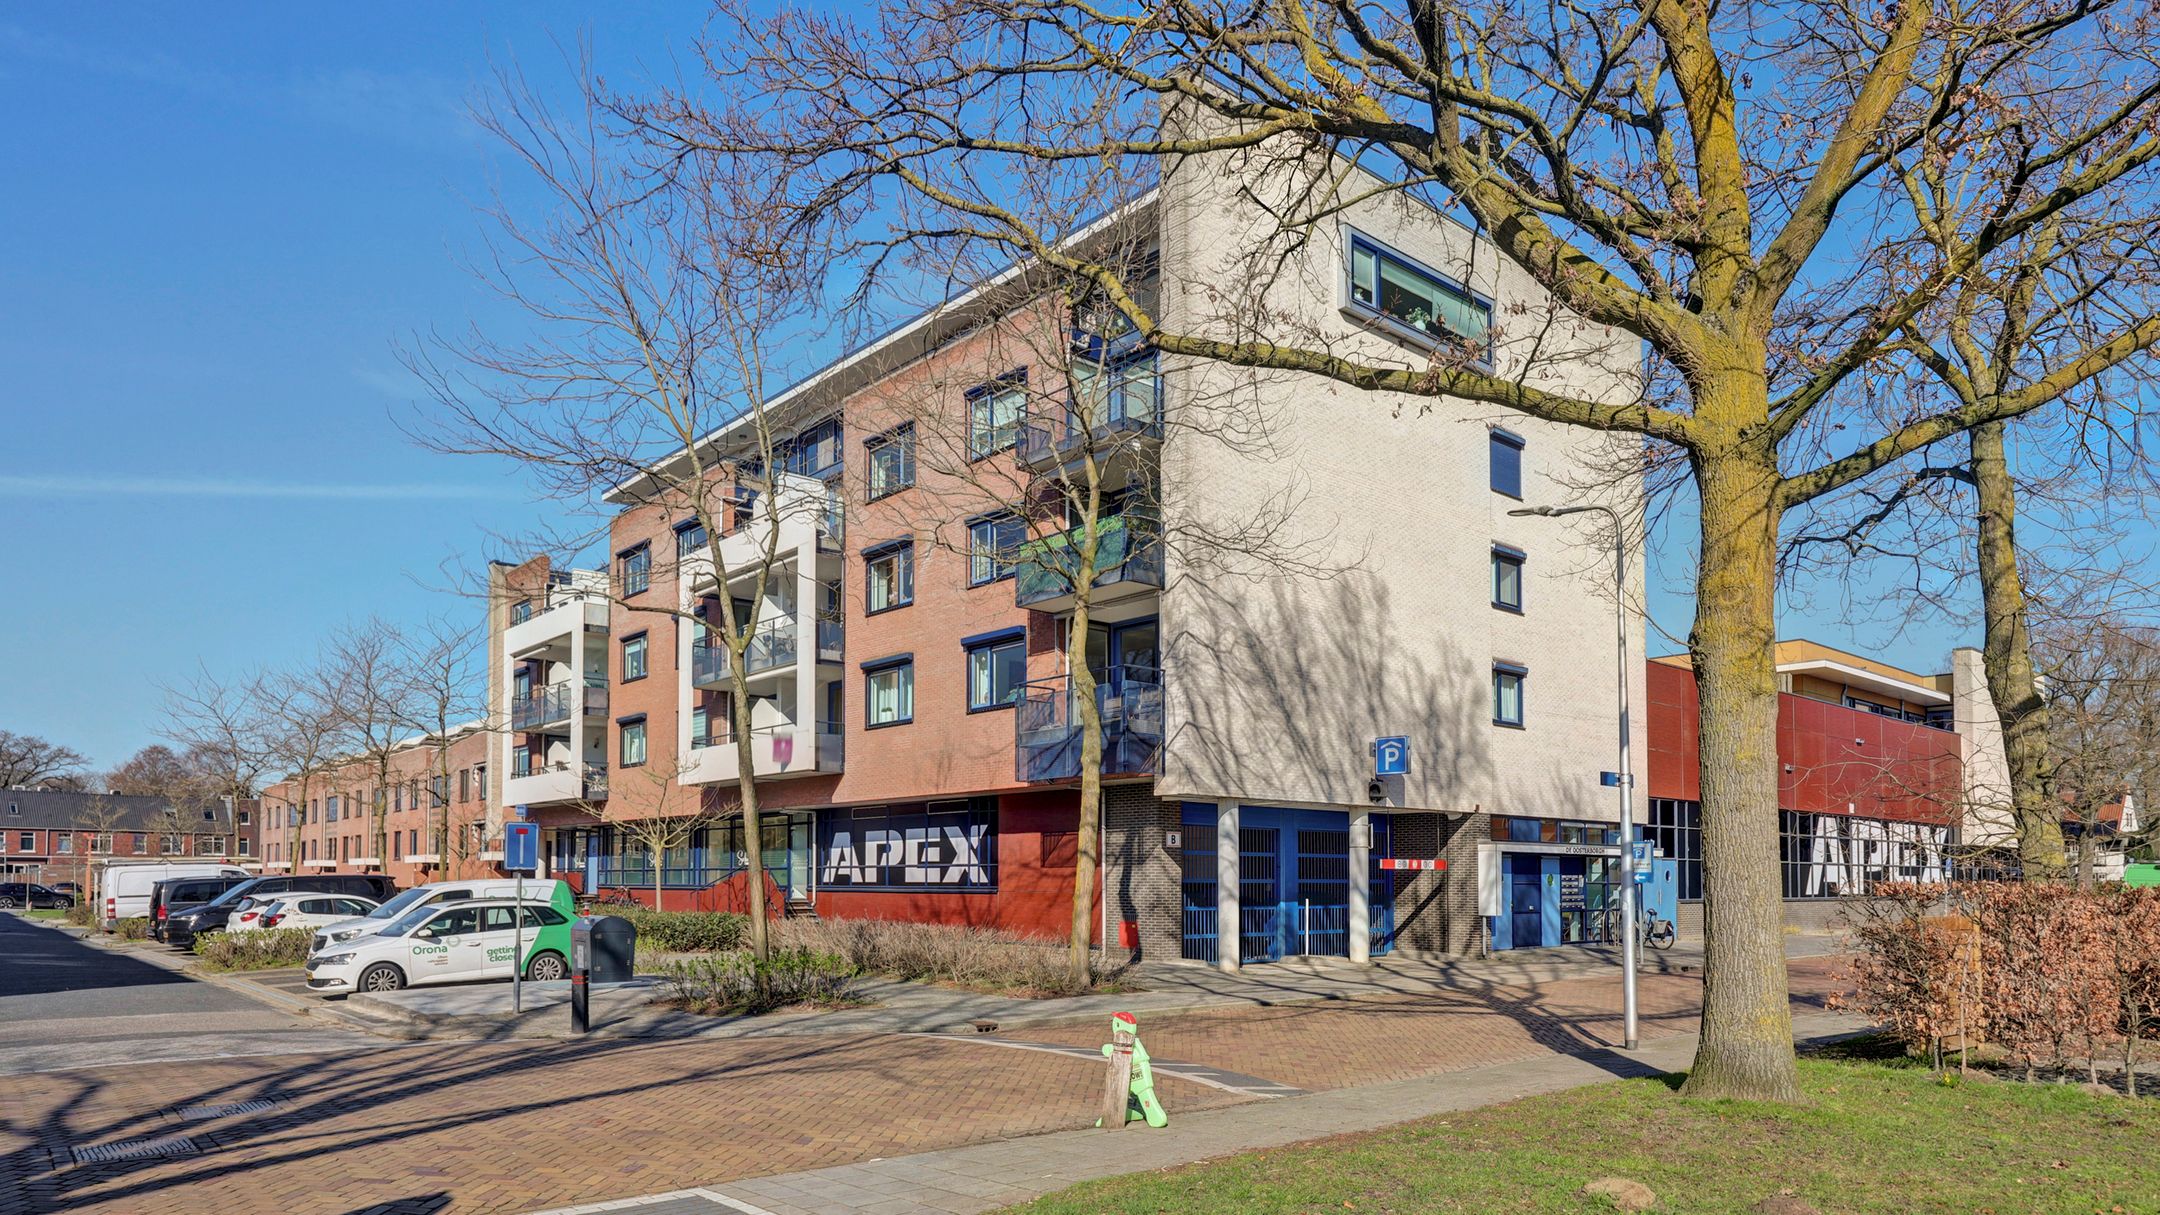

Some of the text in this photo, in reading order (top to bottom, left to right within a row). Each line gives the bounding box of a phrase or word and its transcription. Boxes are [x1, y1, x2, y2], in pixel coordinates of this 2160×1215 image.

[1385, 748, 1399, 770] P
[822, 824, 988, 883] APEX
[1805, 816, 1948, 895] APEX
[412, 946, 448, 955] Orona
[487, 946, 516, 957] gettin
